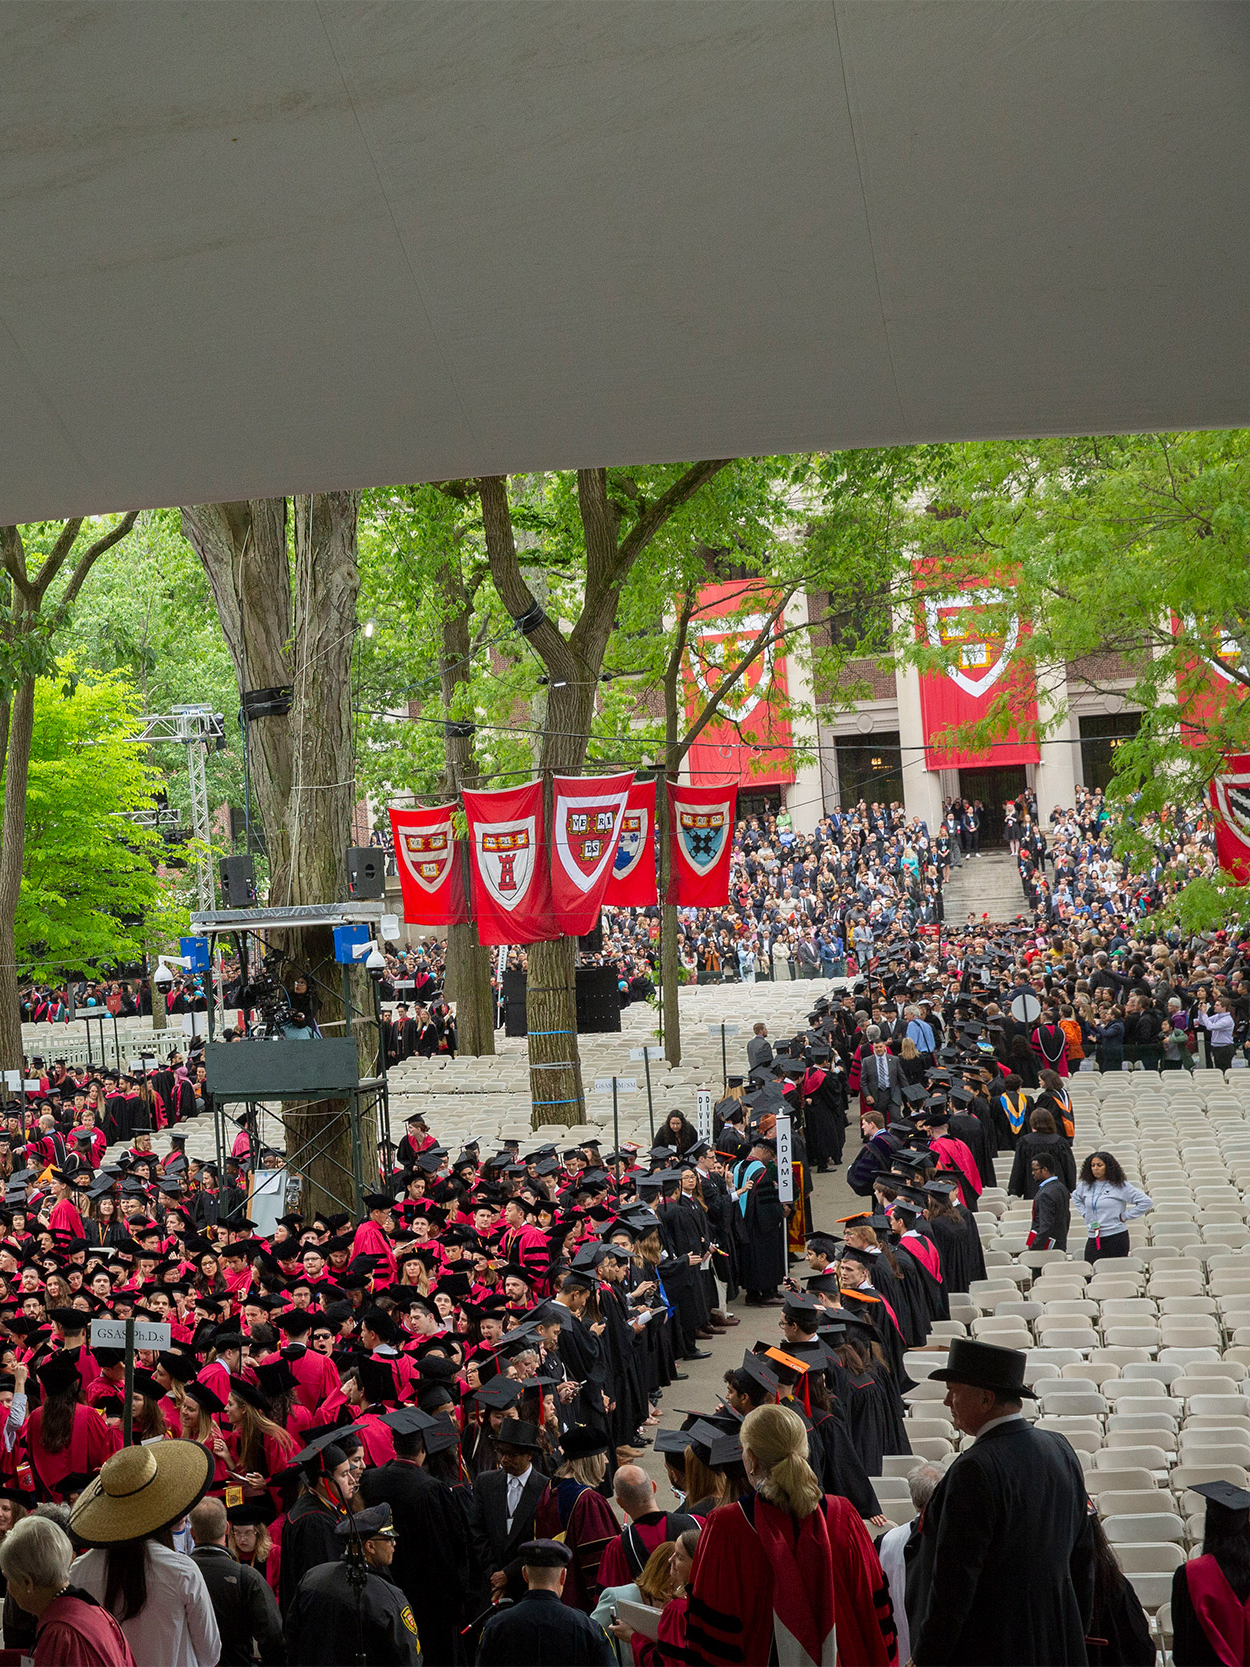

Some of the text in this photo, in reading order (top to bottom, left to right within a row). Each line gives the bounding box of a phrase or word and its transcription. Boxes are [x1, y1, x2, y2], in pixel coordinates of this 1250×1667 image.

[573, 816, 612, 827] VE RI
[586, 844, 599, 853] TAS
[780, 1133, 790, 1188] ADAMS
[97, 1328, 127, 1340] GSAS
